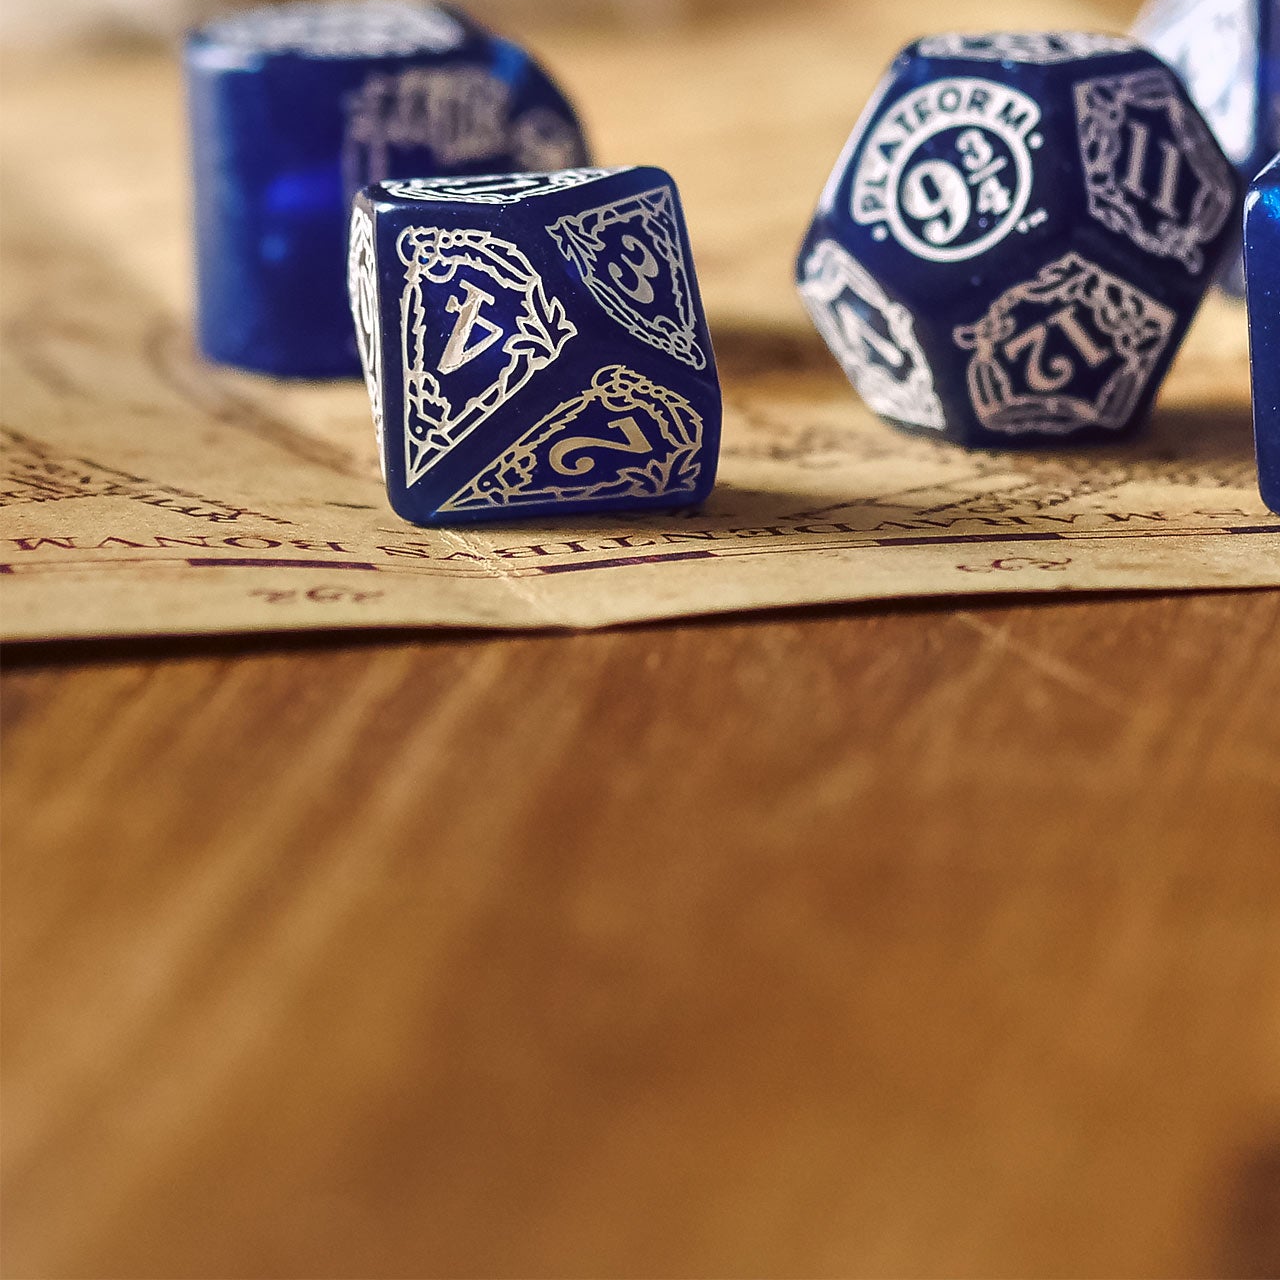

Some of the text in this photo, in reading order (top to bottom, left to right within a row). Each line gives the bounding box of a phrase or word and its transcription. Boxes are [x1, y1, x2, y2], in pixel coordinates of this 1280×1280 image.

[857, 85, 1038, 214] PLATFORM
[606, 233, 660, 305] 3
[436, 279, 503, 376] 4
[1002, 304, 1109, 393] 12
[548, 417, 654, 476] 2
[9, 535, 358, 554] BONVM
